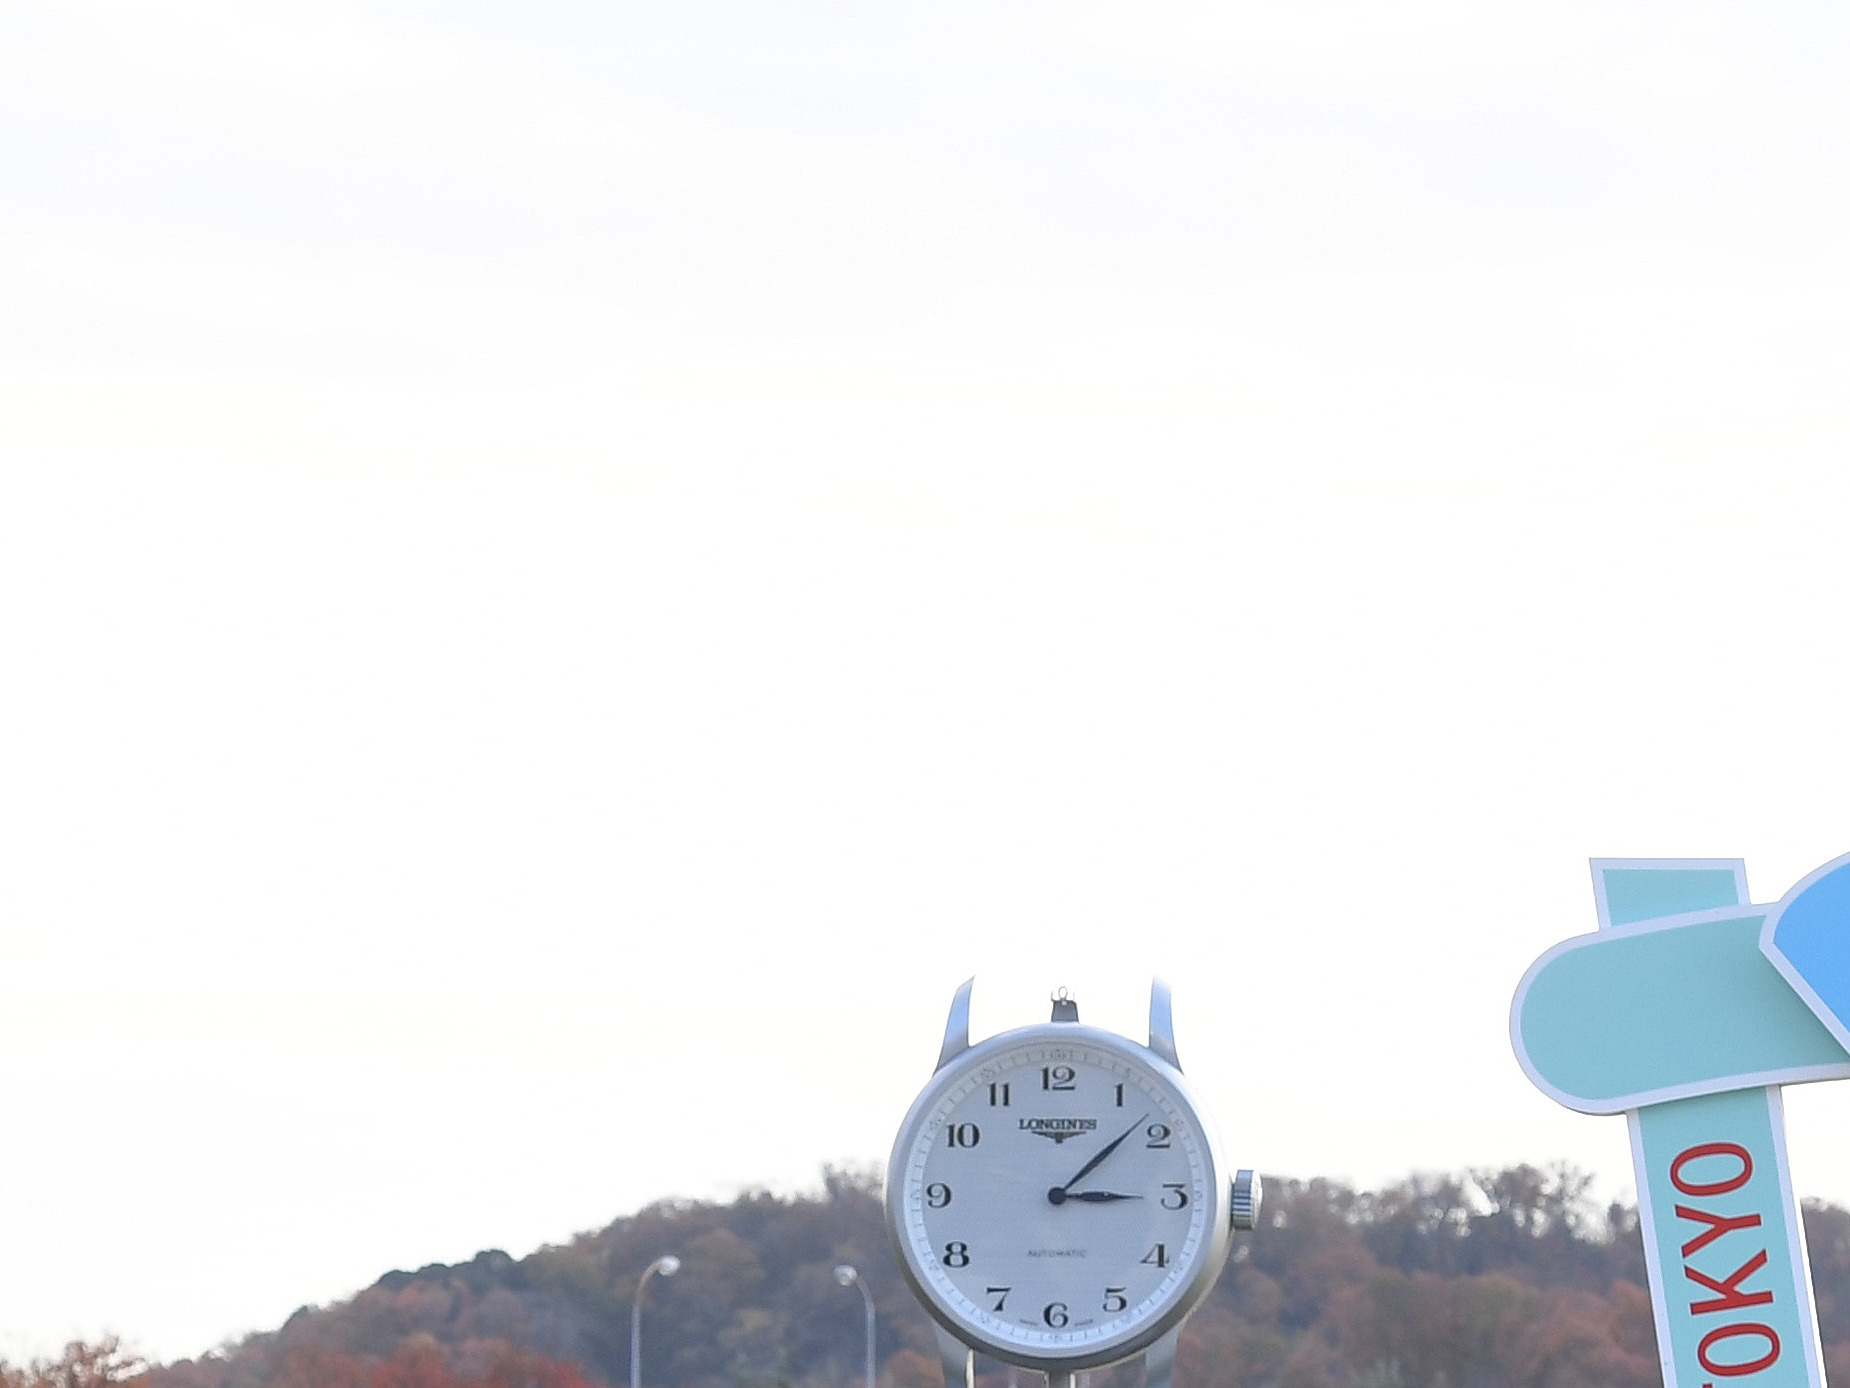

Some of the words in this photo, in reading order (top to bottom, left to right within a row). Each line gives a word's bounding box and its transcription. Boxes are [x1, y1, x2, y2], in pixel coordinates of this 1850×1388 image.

[1042, 1066, 1076, 1091] 12
[989, 1082, 1010, 1106] 11
[1114, 1083, 1124, 1107] 1
[947, 1122, 980, 1148] 10
[1019, 1118, 1097, 1130] LONGINES
[1146, 1123, 1171, 1149] 2
[926, 1182, 952, 1208] 9
[1160, 1183, 1189, 1210] 3
[942, 1241, 970, 1268] 8
[1140, 1243, 1170, 1268] 4
[986, 1287, 1011, 1312] 7
[1102, 1287, 1127, 1312] 5
[1043, 1302, 1069, 1328] 6
